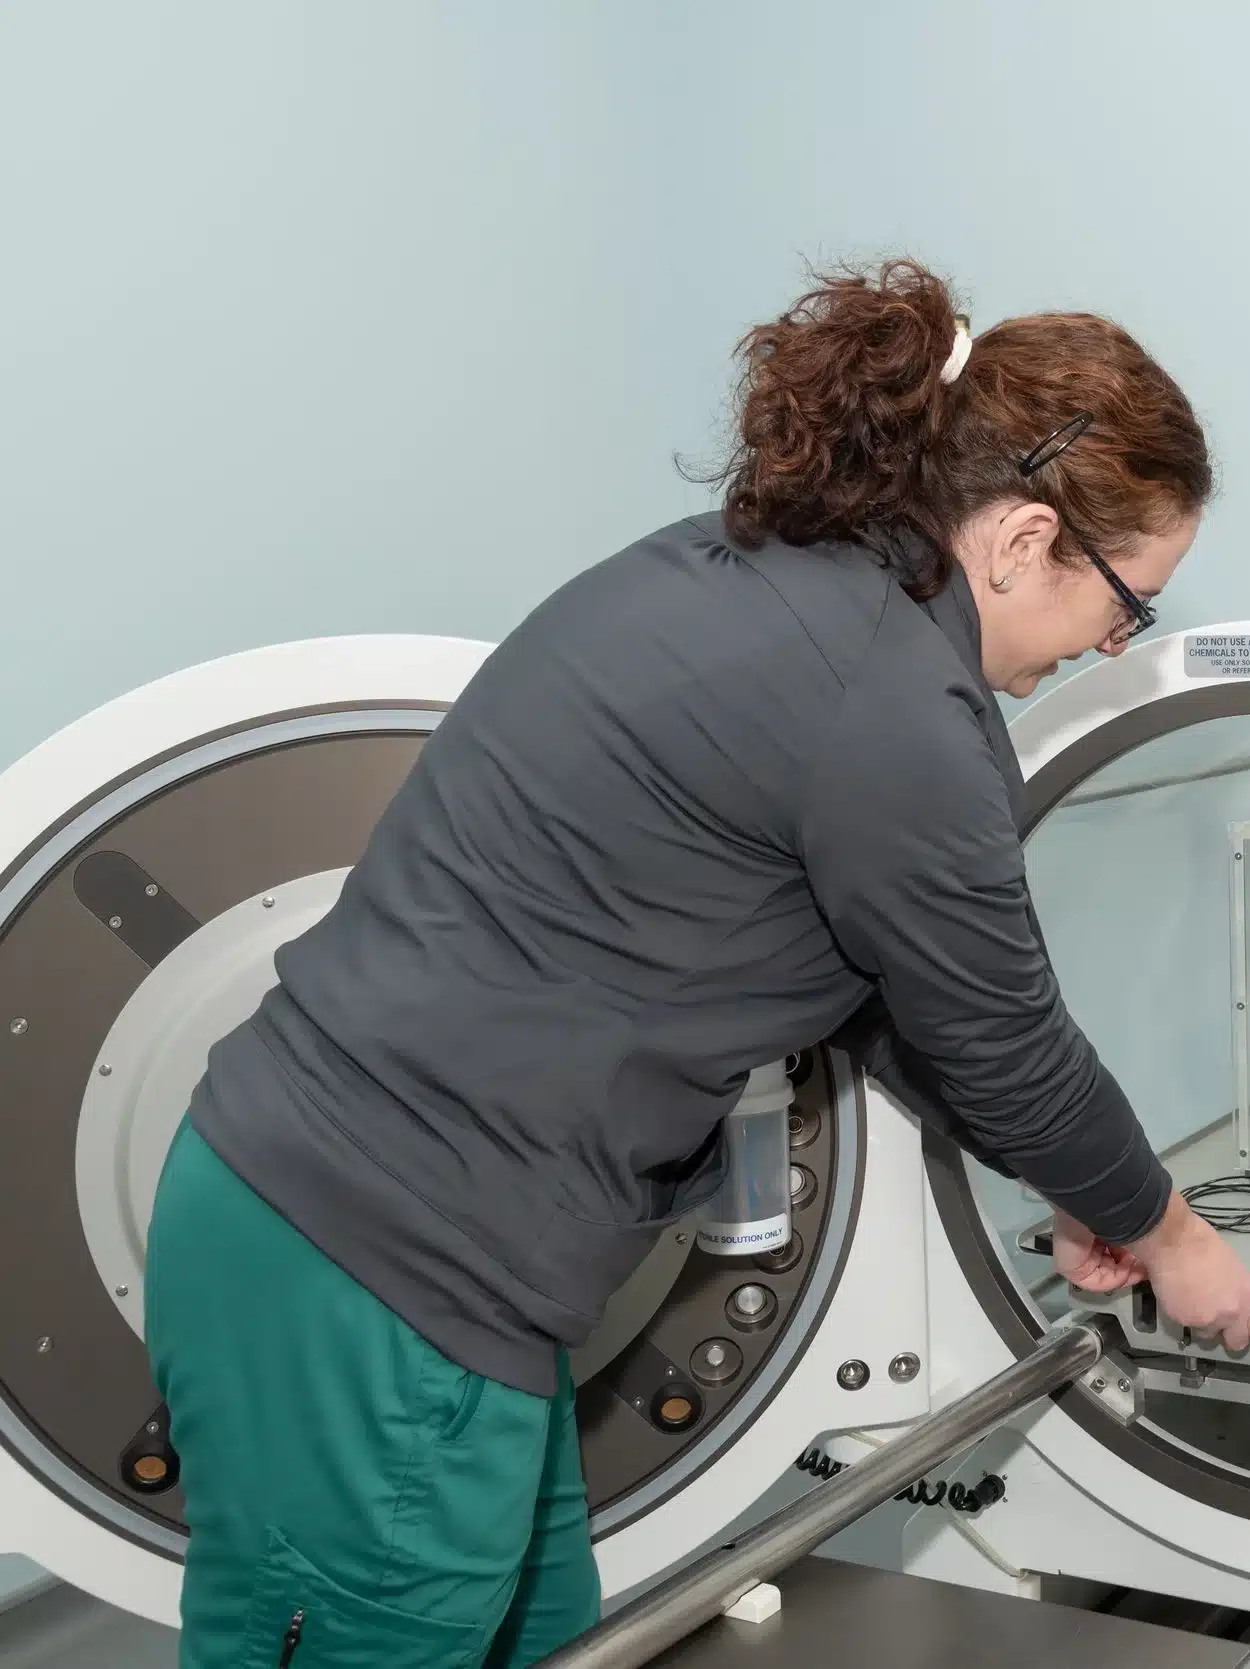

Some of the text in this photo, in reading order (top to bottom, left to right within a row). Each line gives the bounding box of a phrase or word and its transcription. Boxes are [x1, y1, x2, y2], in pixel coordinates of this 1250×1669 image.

[1196, 637, 1208, 646] DO
[1210, 637, 1228, 646] NOT
[1230, 637, 1246, 646] USE
[1189, 649, 1236, 657] CHEMICALS
[1238, 649, 1249, 657] TO
[720, 1234, 763, 1244] SOLUTION
[764, 1227, 783, 1239] ONLY
